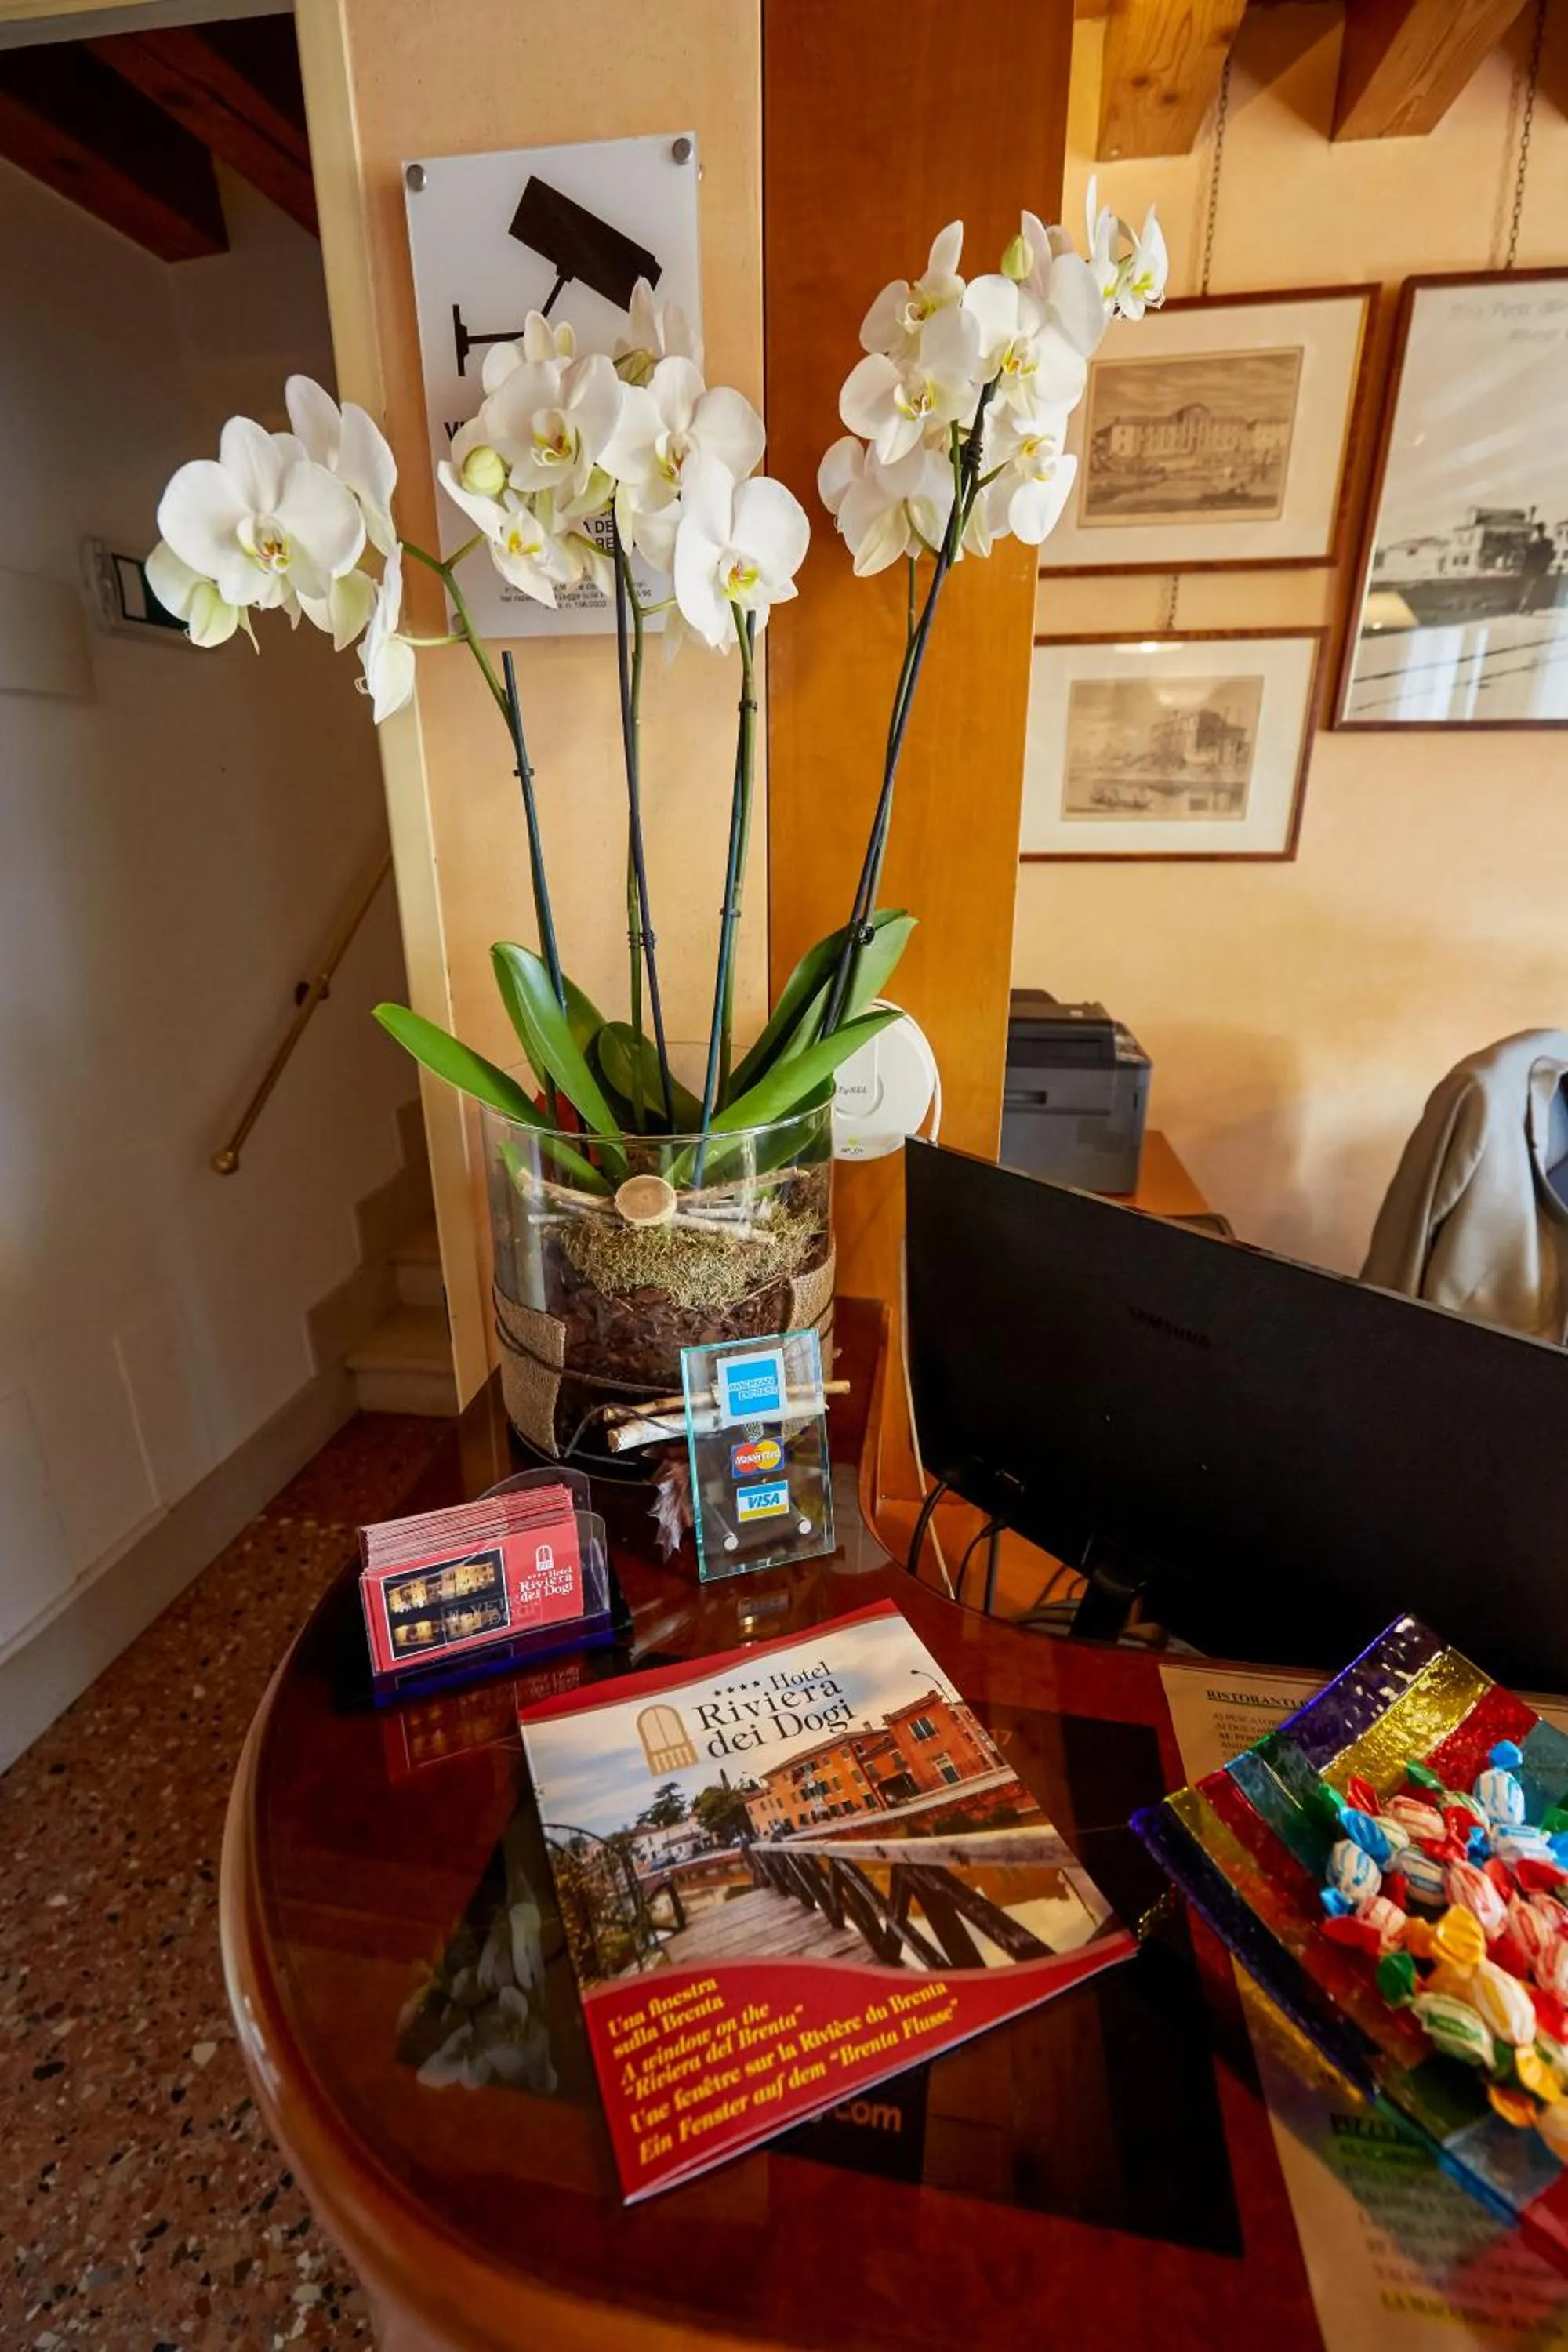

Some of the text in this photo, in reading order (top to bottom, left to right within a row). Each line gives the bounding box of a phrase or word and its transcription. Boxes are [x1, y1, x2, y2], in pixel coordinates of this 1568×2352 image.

[747, 1493, 780, 1509] VISA
[519, 1575, 573, 1592] Riviera
[520, 1582, 573, 1603] dei Dogi
[549, 1566, 573, 1578] Hotel
[768, 1661, 833, 1690] Hotel
[692, 1679, 843, 1730] Riviera
[707, 1699, 857, 1758] dei Dogi
[608, 1978, 718, 2037] Una finestra
[613, 1996, 724, 2059] sulla Brenta
[621, 2004, 769, 2087] A window on the
[630, 1982, 948, 2133] Une fenêtre sur la Rivière du Brenta
[706, 2035, 733, 2064] del
[640, 2133, 673, 2165] Ein
[679, 2096, 748, 2142] Fenster
[753, 2071, 785, 2105] auf
[788, 2061, 826, 2089] dem
